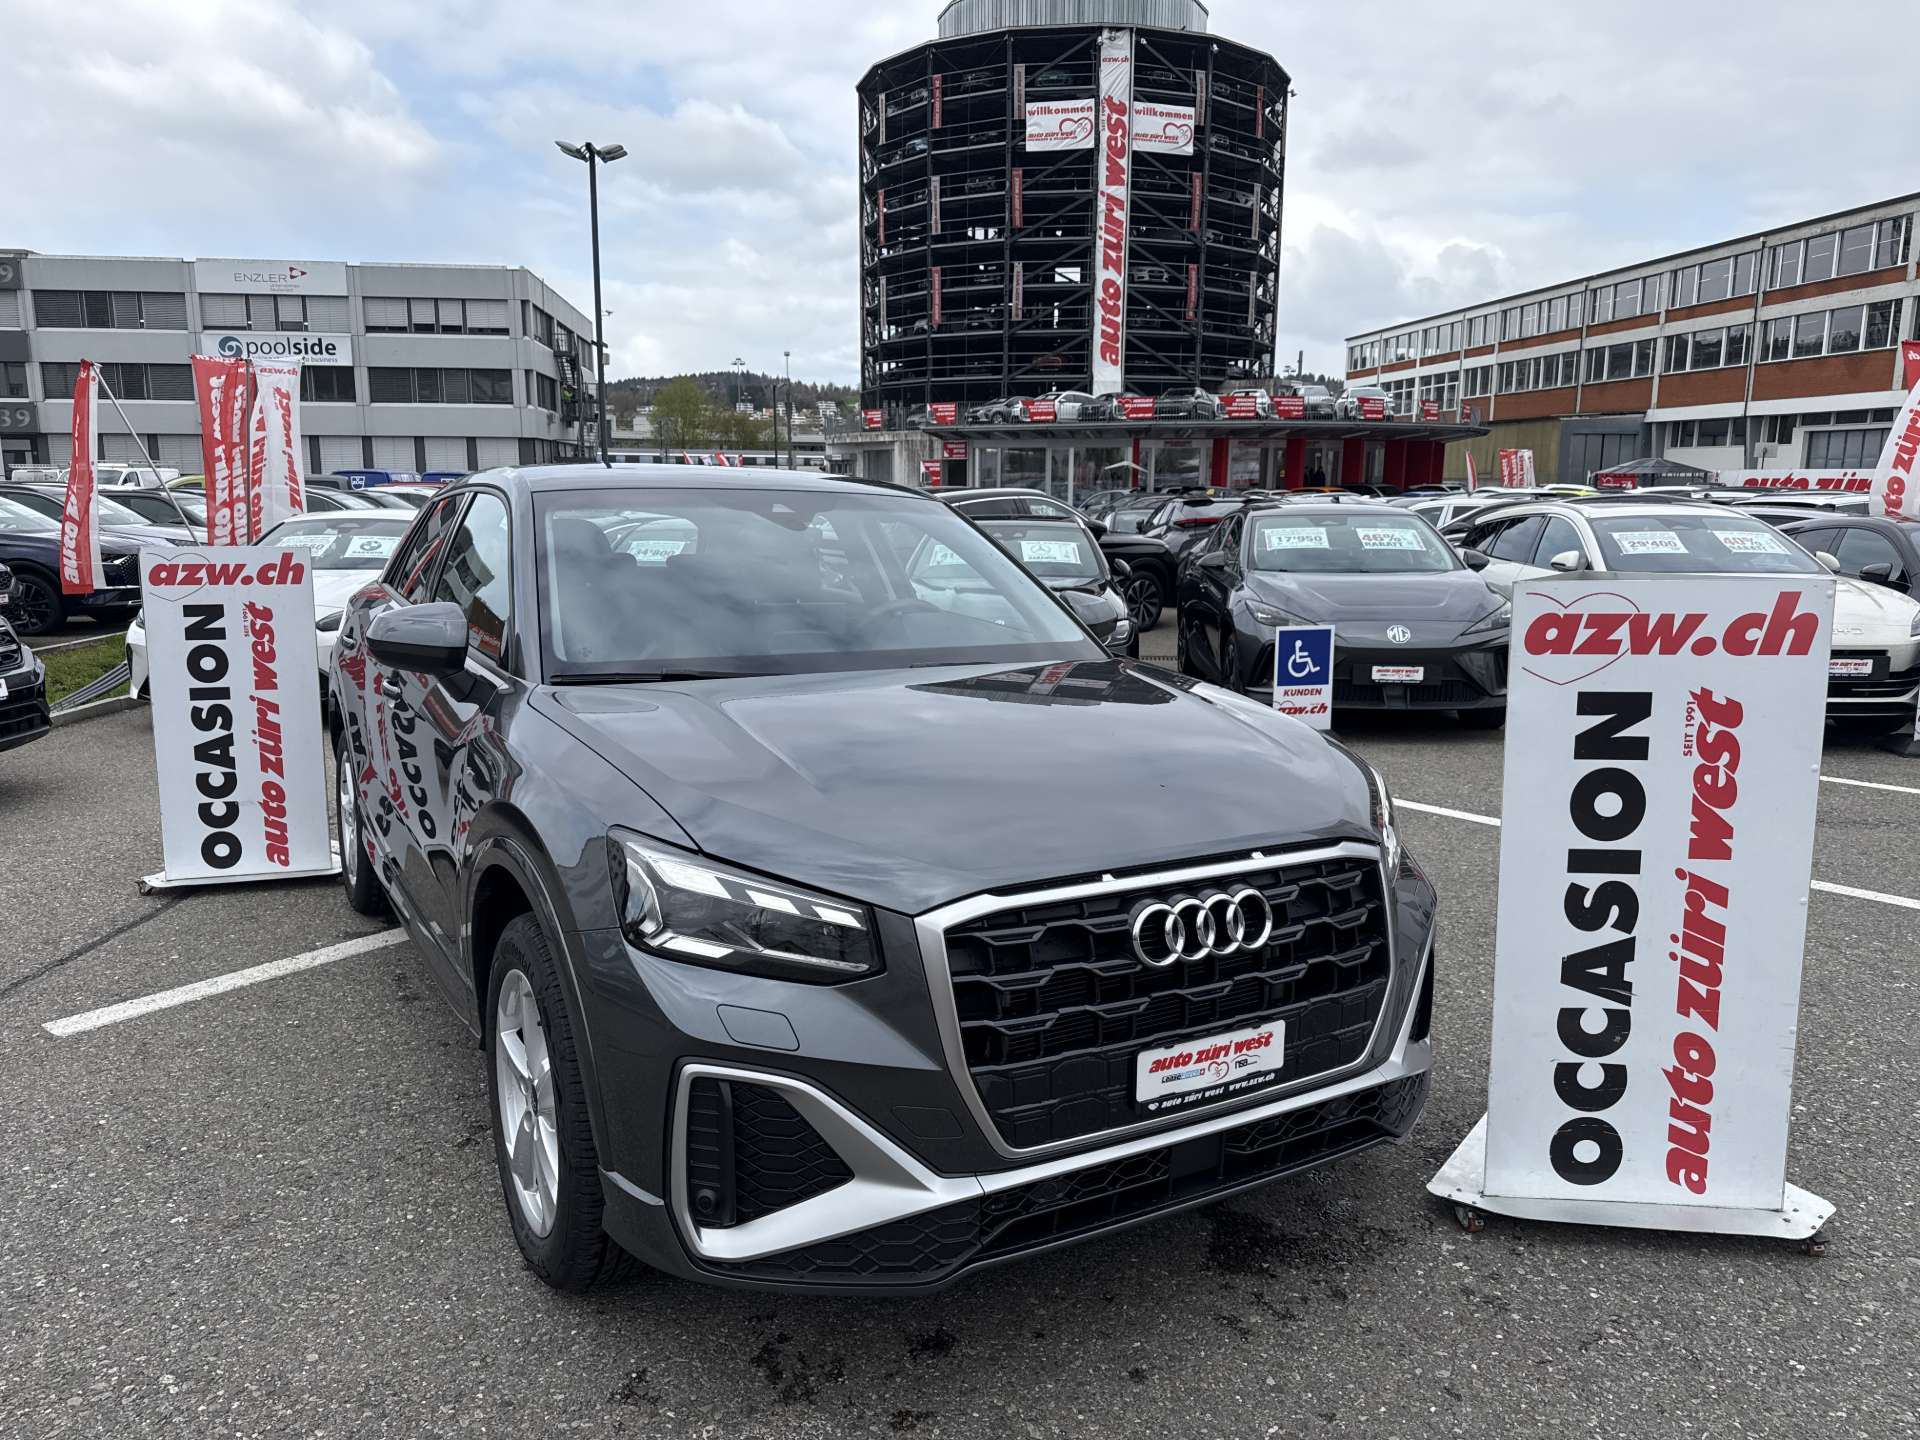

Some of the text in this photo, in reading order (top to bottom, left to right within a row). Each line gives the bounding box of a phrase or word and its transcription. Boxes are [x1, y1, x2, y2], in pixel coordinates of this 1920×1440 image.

[1027, 105, 1093, 117] willkommen
[1134, 107, 1193, 119] willkommen
[1097, 95, 1128, 367] auto züri west
[234, 272, 288, 283] ENZLER
[246, 336, 337, 358] poolside
[63, 522, 80, 584] auto
[148, 552, 304, 586] azw.ch
[1524, 591, 1819, 657] azw.ch
[1283, 688, 1323, 697] KUNDEN
[182, 603, 243, 869] OCCASION
[243, 601, 290, 868] auto züri west
[1683, 700, 1695, 757] SEIT 1991
[1549, 691, 1654, 1186] OCCASION
[1661, 687, 1745, 1194] auto züri west
[1149, 1031, 1273, 1074] auto züri west
[1161, 1097, 1181, 1109] auto
[1205, 1087, 1224, 1099] west
